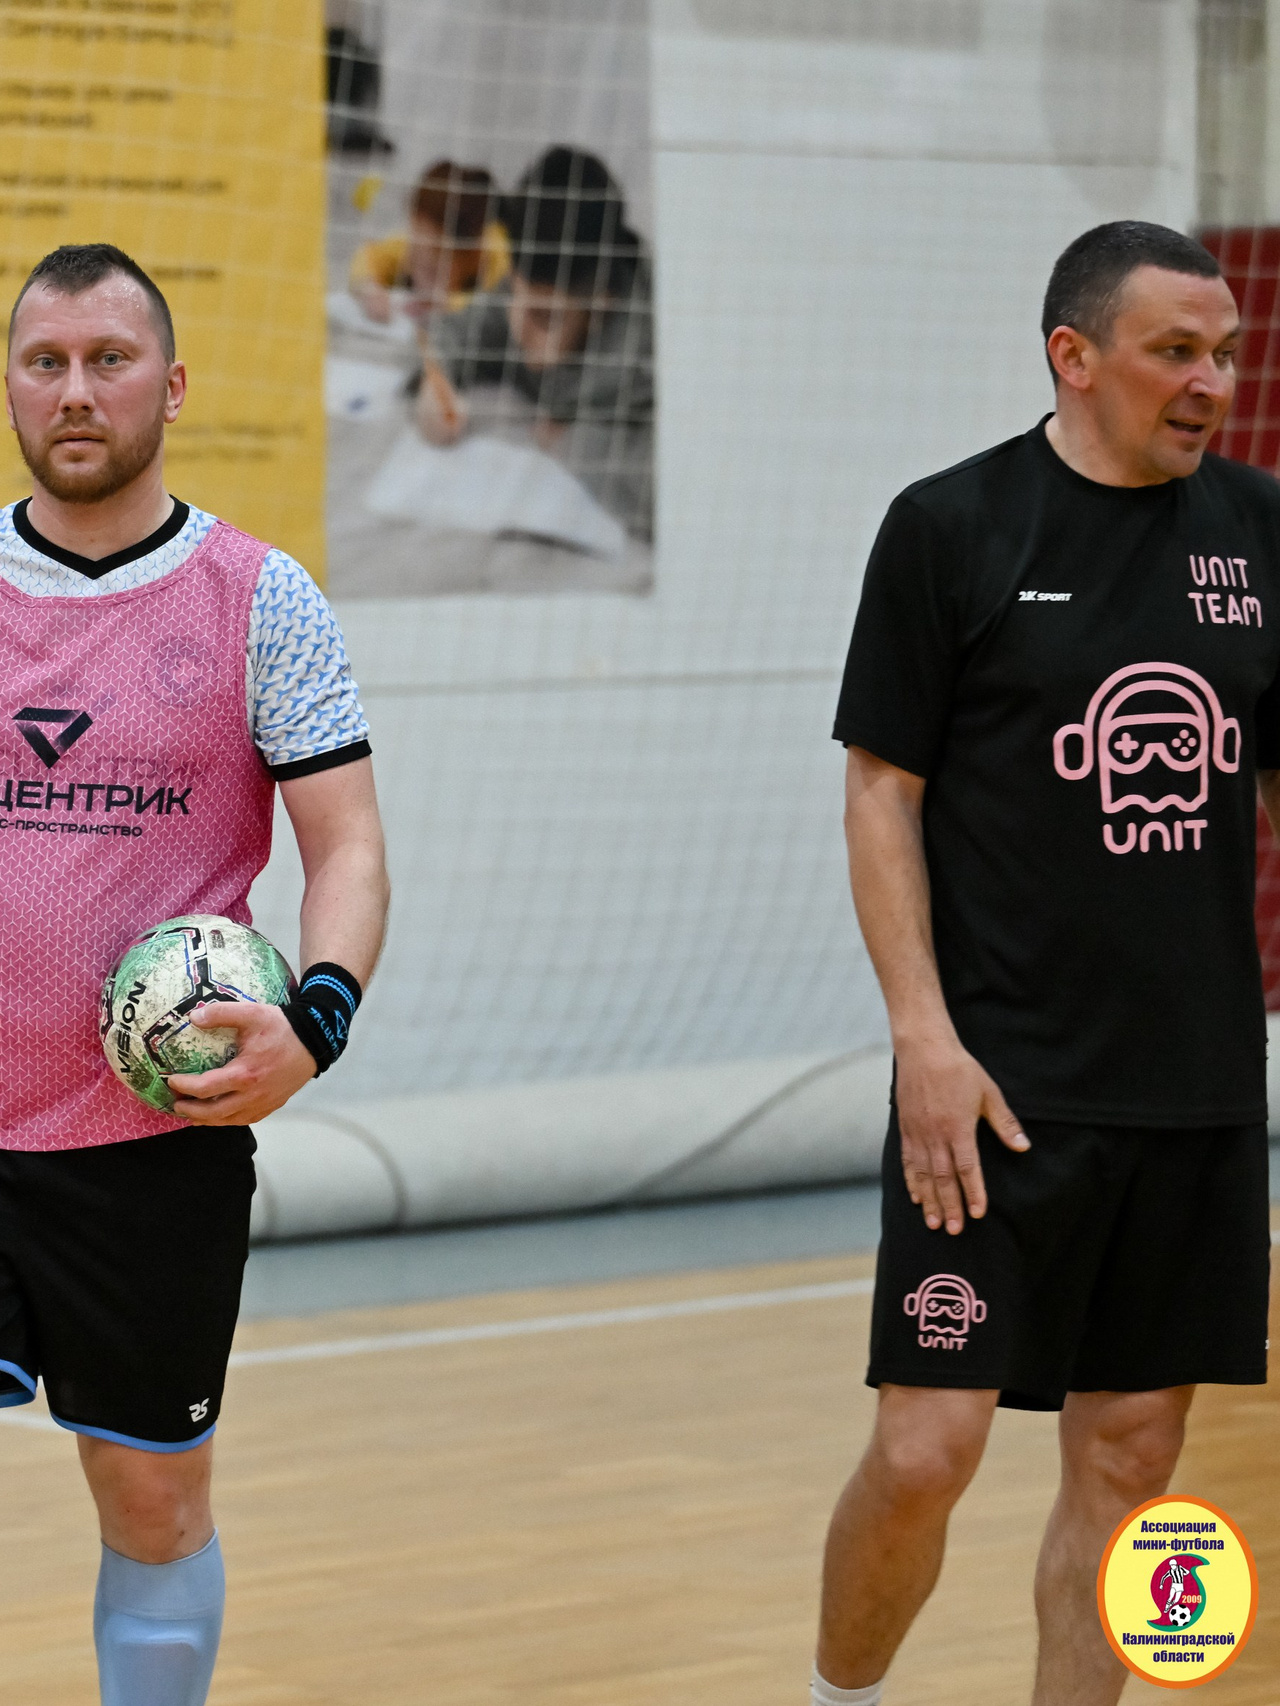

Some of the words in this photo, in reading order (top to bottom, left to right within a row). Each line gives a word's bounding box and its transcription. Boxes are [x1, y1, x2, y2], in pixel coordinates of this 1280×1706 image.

[1189, 554, 1248, 589] UNIT
[1036, 592, 1073, 602] SPORT
[1187, 592, 1262, 628] TEAM
[1102, 819, 1209, 855] UNIT
[114, 981, 148, 1073] VISION
[917, 1334, 968, 1350] UNIT
